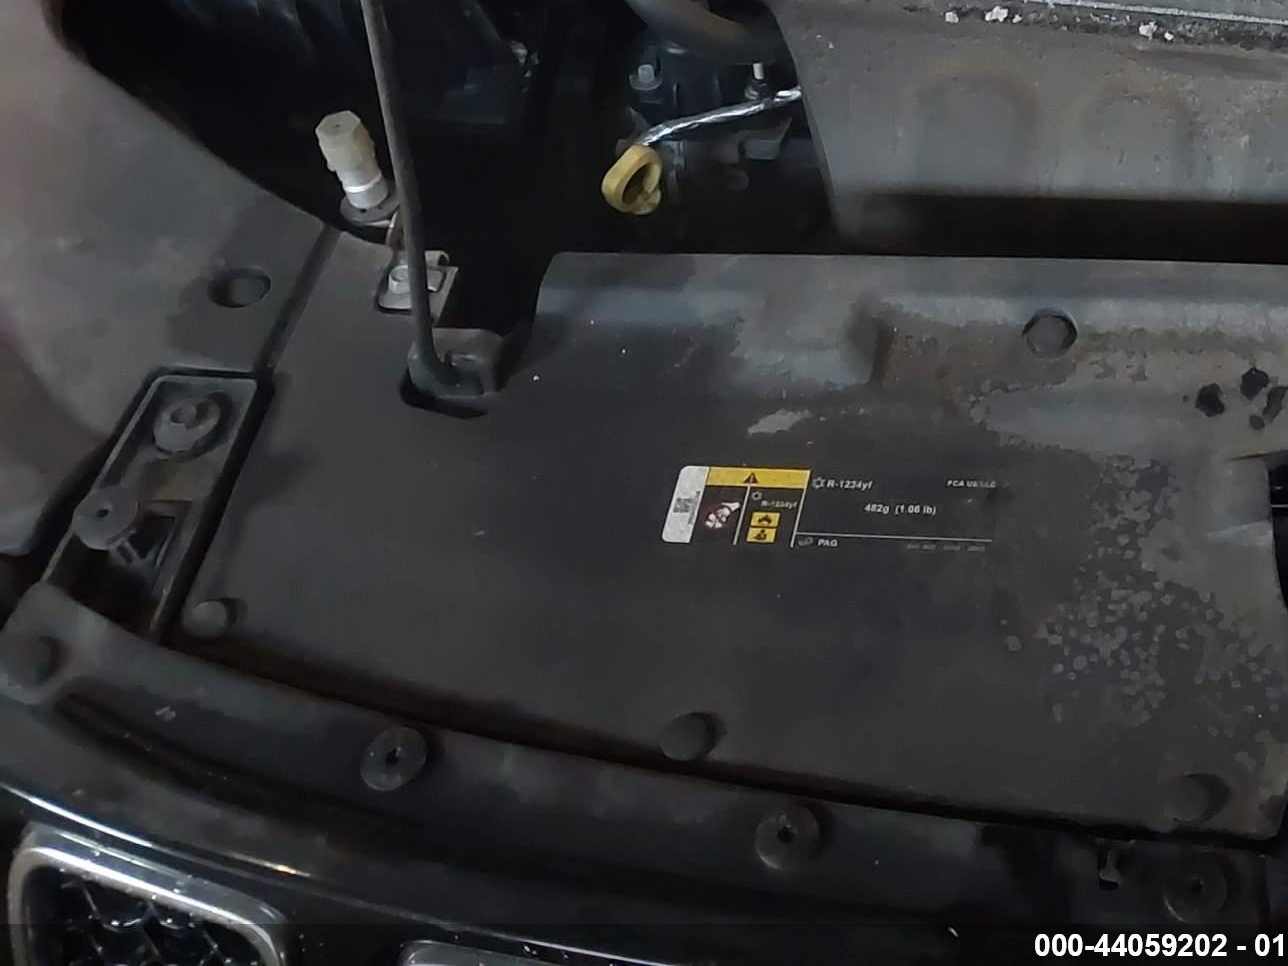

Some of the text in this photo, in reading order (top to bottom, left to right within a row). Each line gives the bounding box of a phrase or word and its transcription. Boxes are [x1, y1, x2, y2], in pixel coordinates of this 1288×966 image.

[826, 478, 873, 491] R-1234yf
[947, 479, 964, 488] FCA
[864, 503, 890, 514] 482g
[923, 506, 937, 516] lb)
[817, 538, 838, 548] PAG
